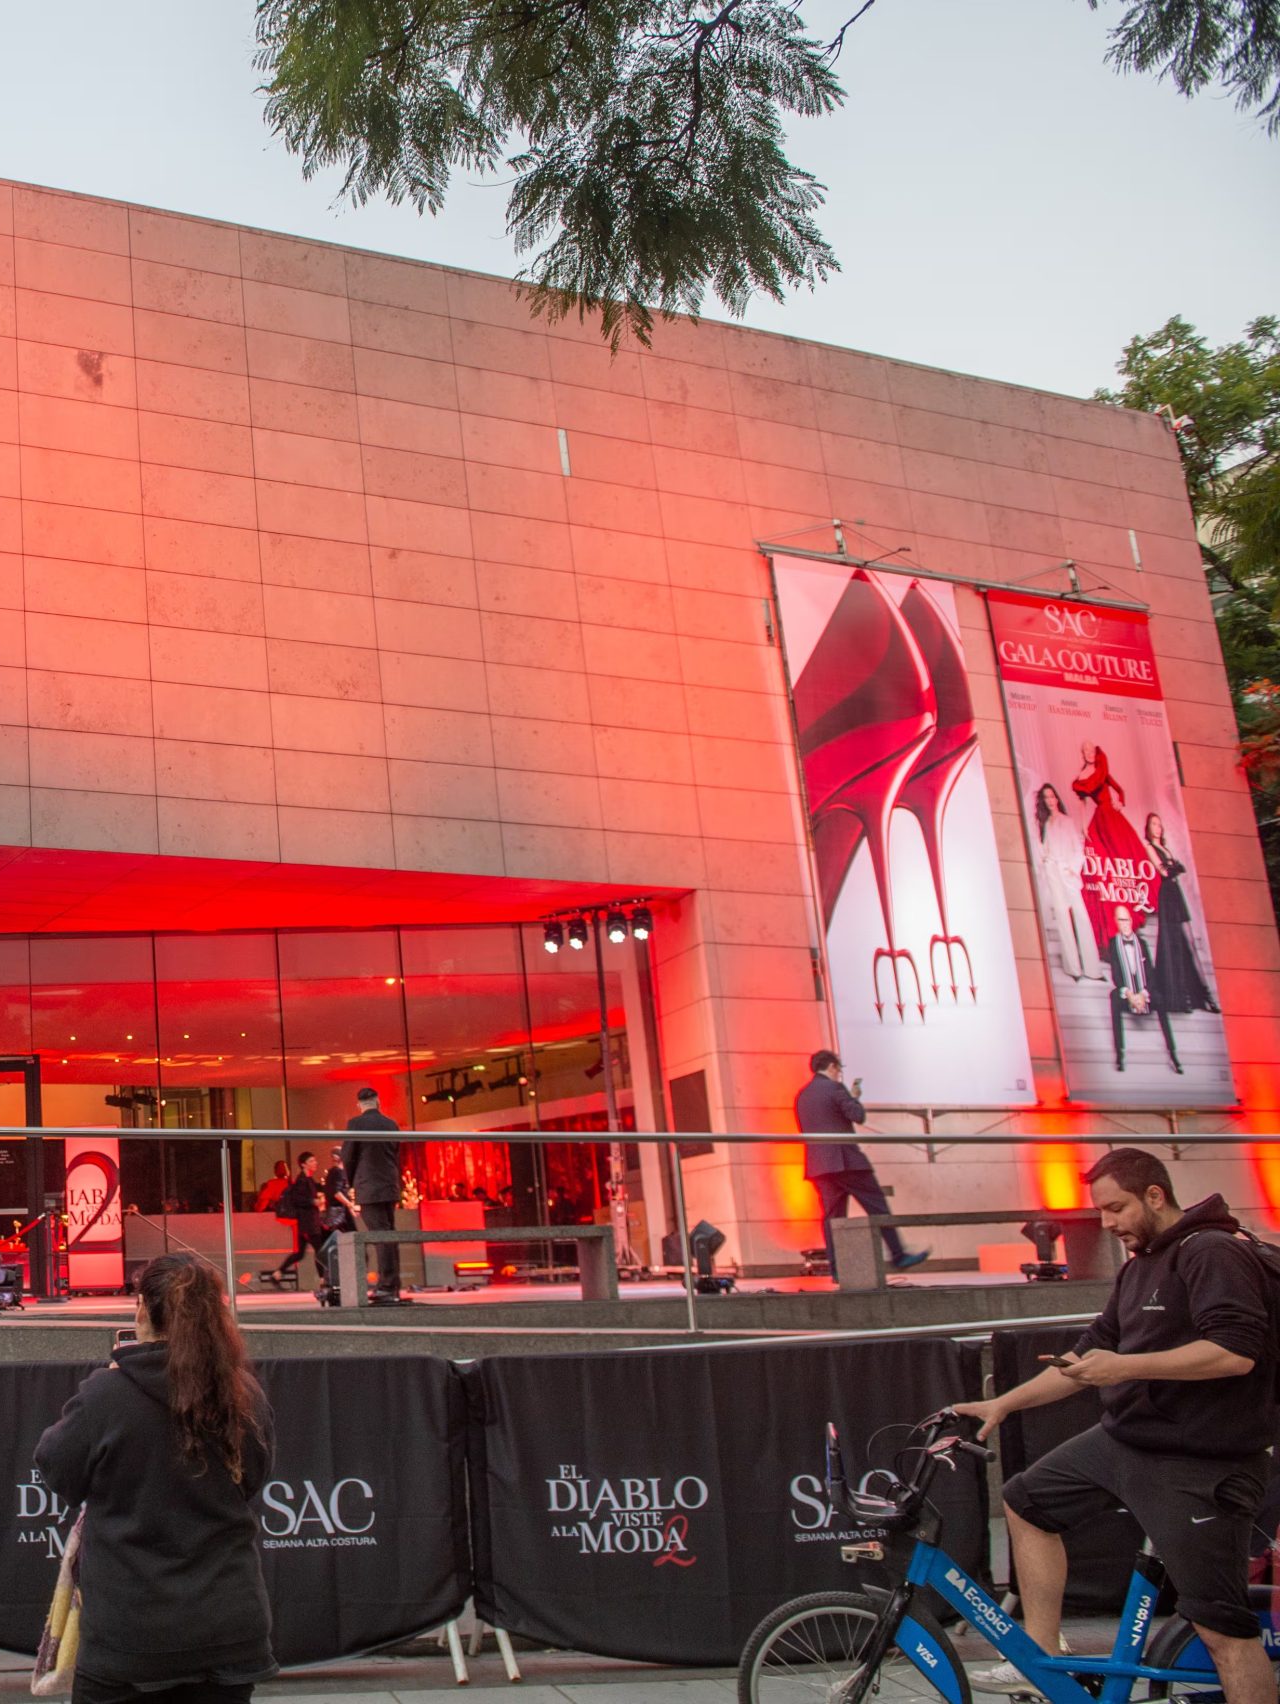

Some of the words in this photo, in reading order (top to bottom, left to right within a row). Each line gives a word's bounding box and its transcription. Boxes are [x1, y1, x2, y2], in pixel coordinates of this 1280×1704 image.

[1044, 604, 1098, 638] SAC
[1000, 641, 1057, 668] GALA
[1057, 650, 1153, 681] COUTURE
[1082, 856, 1156, 881] DIABLO
[559, 1464, 582, 1479] EL
[261, 1478, 375, 1536] SAC
[545, 1476, 708, 1520] DIABLO
[610, 1511, 663, 1528] VISTE
[263, 1539, 304, 1549] SEMANA
[306, 1538, 330, 1547] ALTA
[330, 1536, 378, 1547] COSTURA
[577, 1521, 687, 1553] MODA
[795, 1532, 836, 1542] SEMANA
[838, 1531, 860, 1540] ALTA
[963, 1587, 1013, 1635] Ecobici
[1131, 1595, 1151, 1646] 3827
[915, 1642, 938, 1669] VISA
